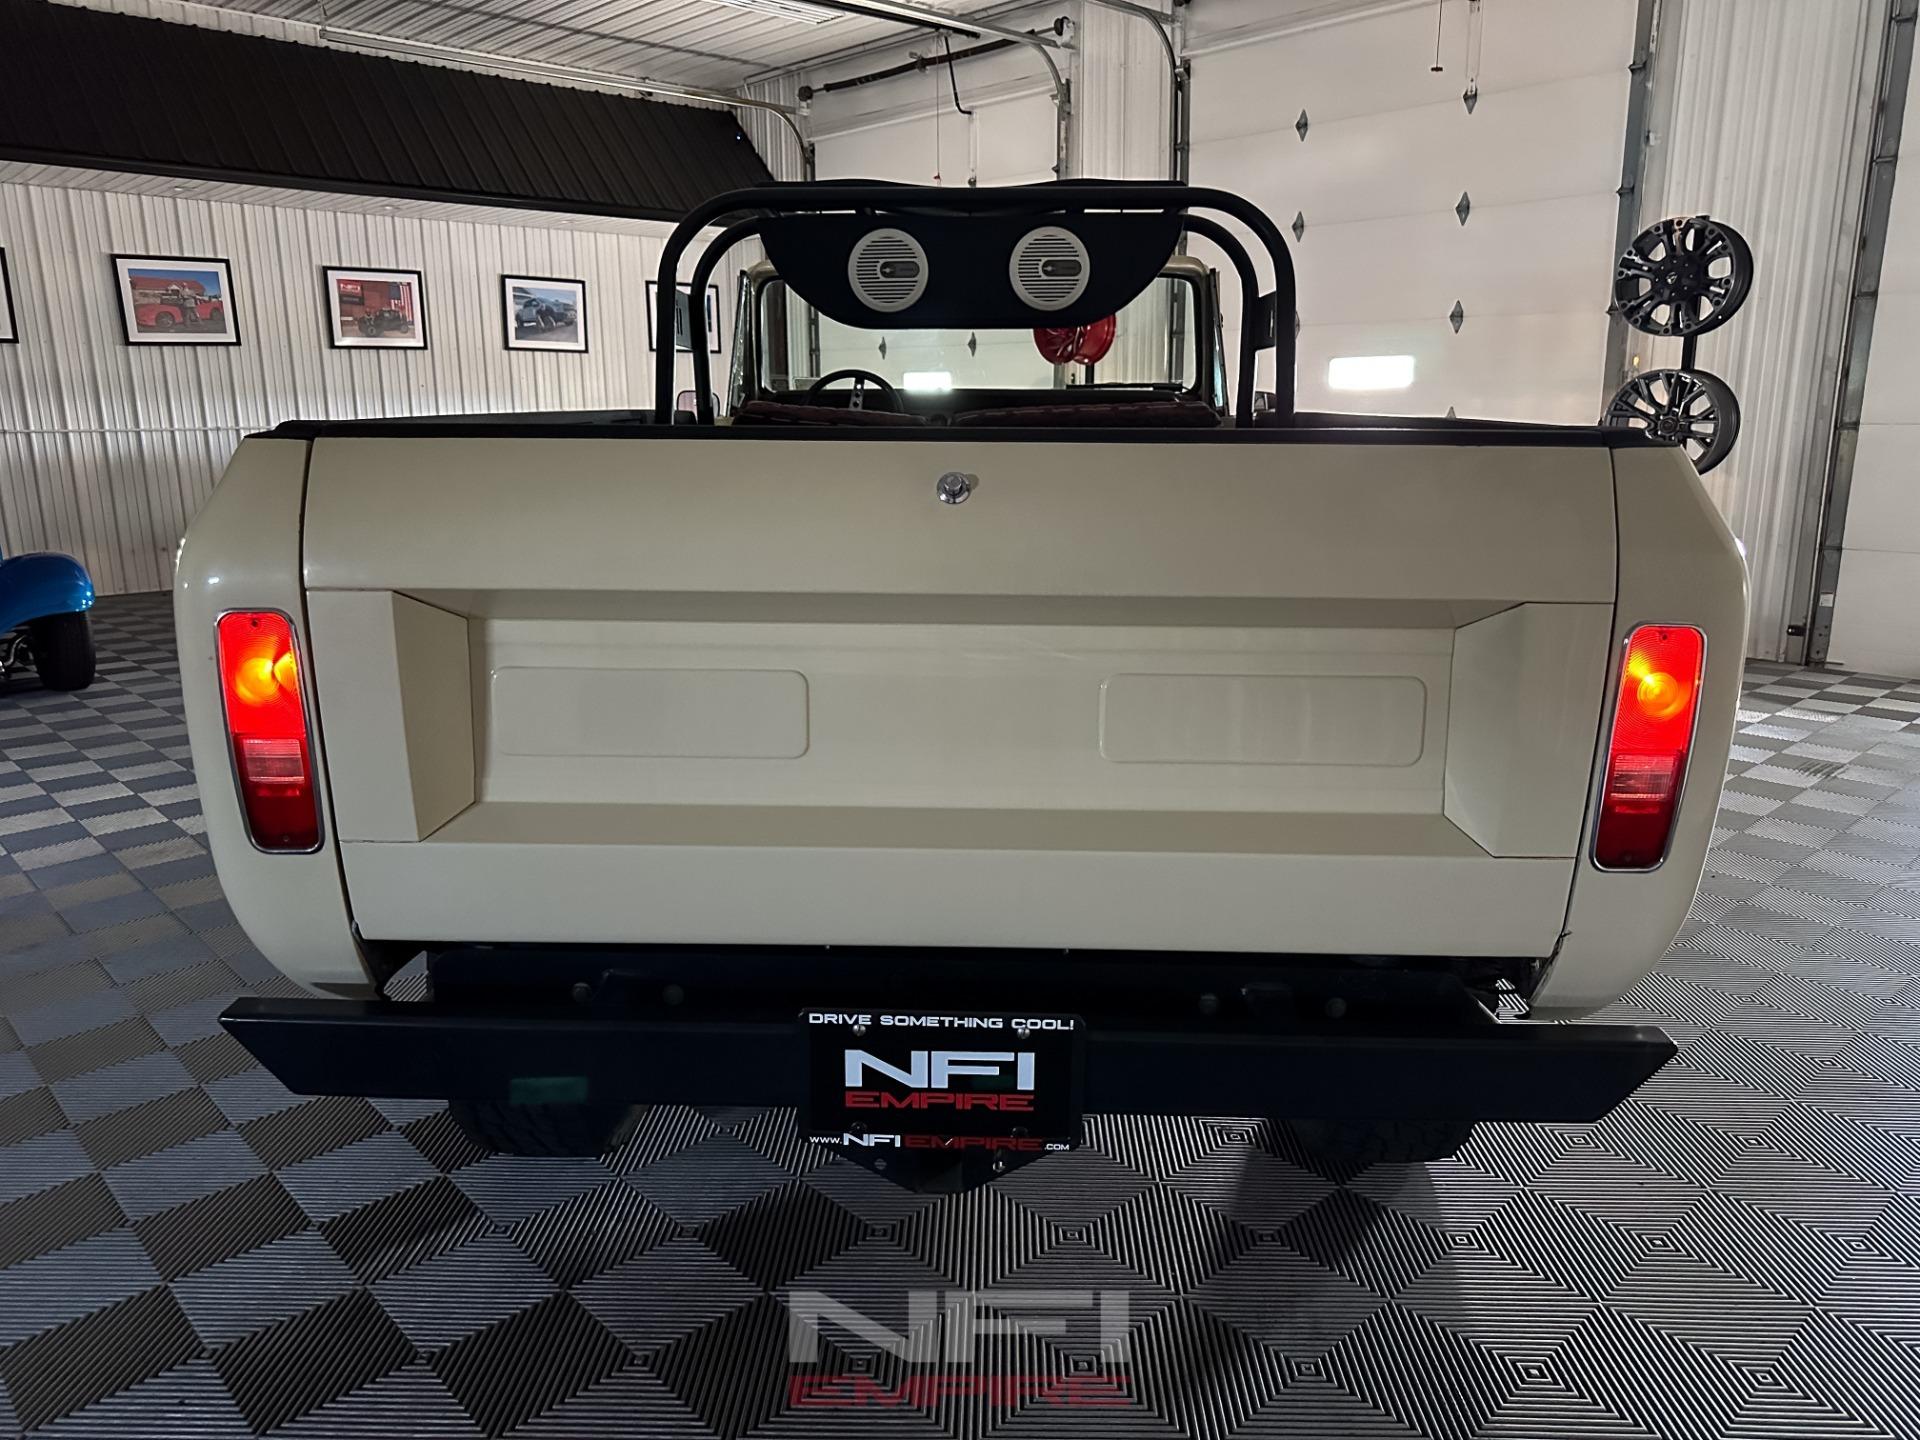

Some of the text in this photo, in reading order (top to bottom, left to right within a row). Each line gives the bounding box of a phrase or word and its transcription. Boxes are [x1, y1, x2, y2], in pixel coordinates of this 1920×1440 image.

[808, 1013, 1074, 1031] DRIVE SOMETHING COOL!
[844, 1049, 1036, 1091] NFI
[844, 1091, 1035, 1112] EMPIRE
